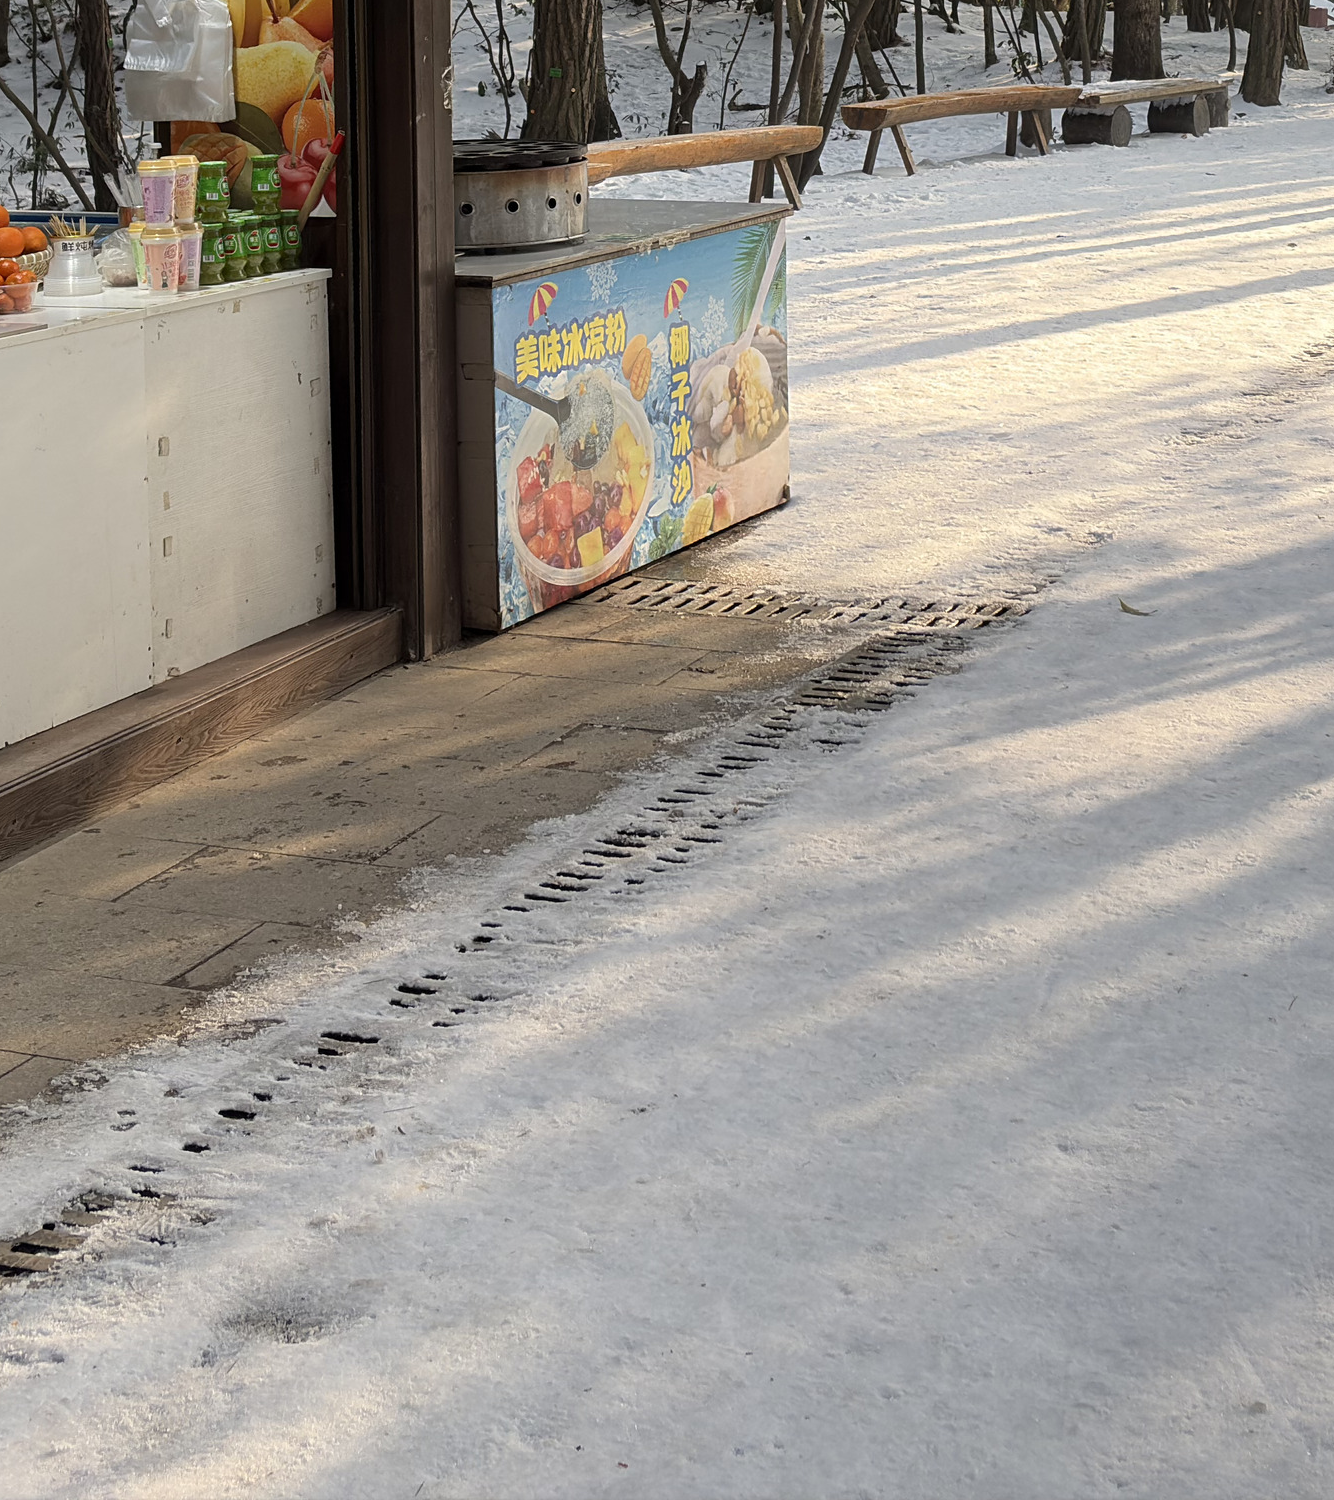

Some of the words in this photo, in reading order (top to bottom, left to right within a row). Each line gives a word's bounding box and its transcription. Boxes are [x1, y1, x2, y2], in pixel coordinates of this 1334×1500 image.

[515, 310, 626, 383] 美味冰凉粉
[668, 324, 693, 506] 椰子冰沙
